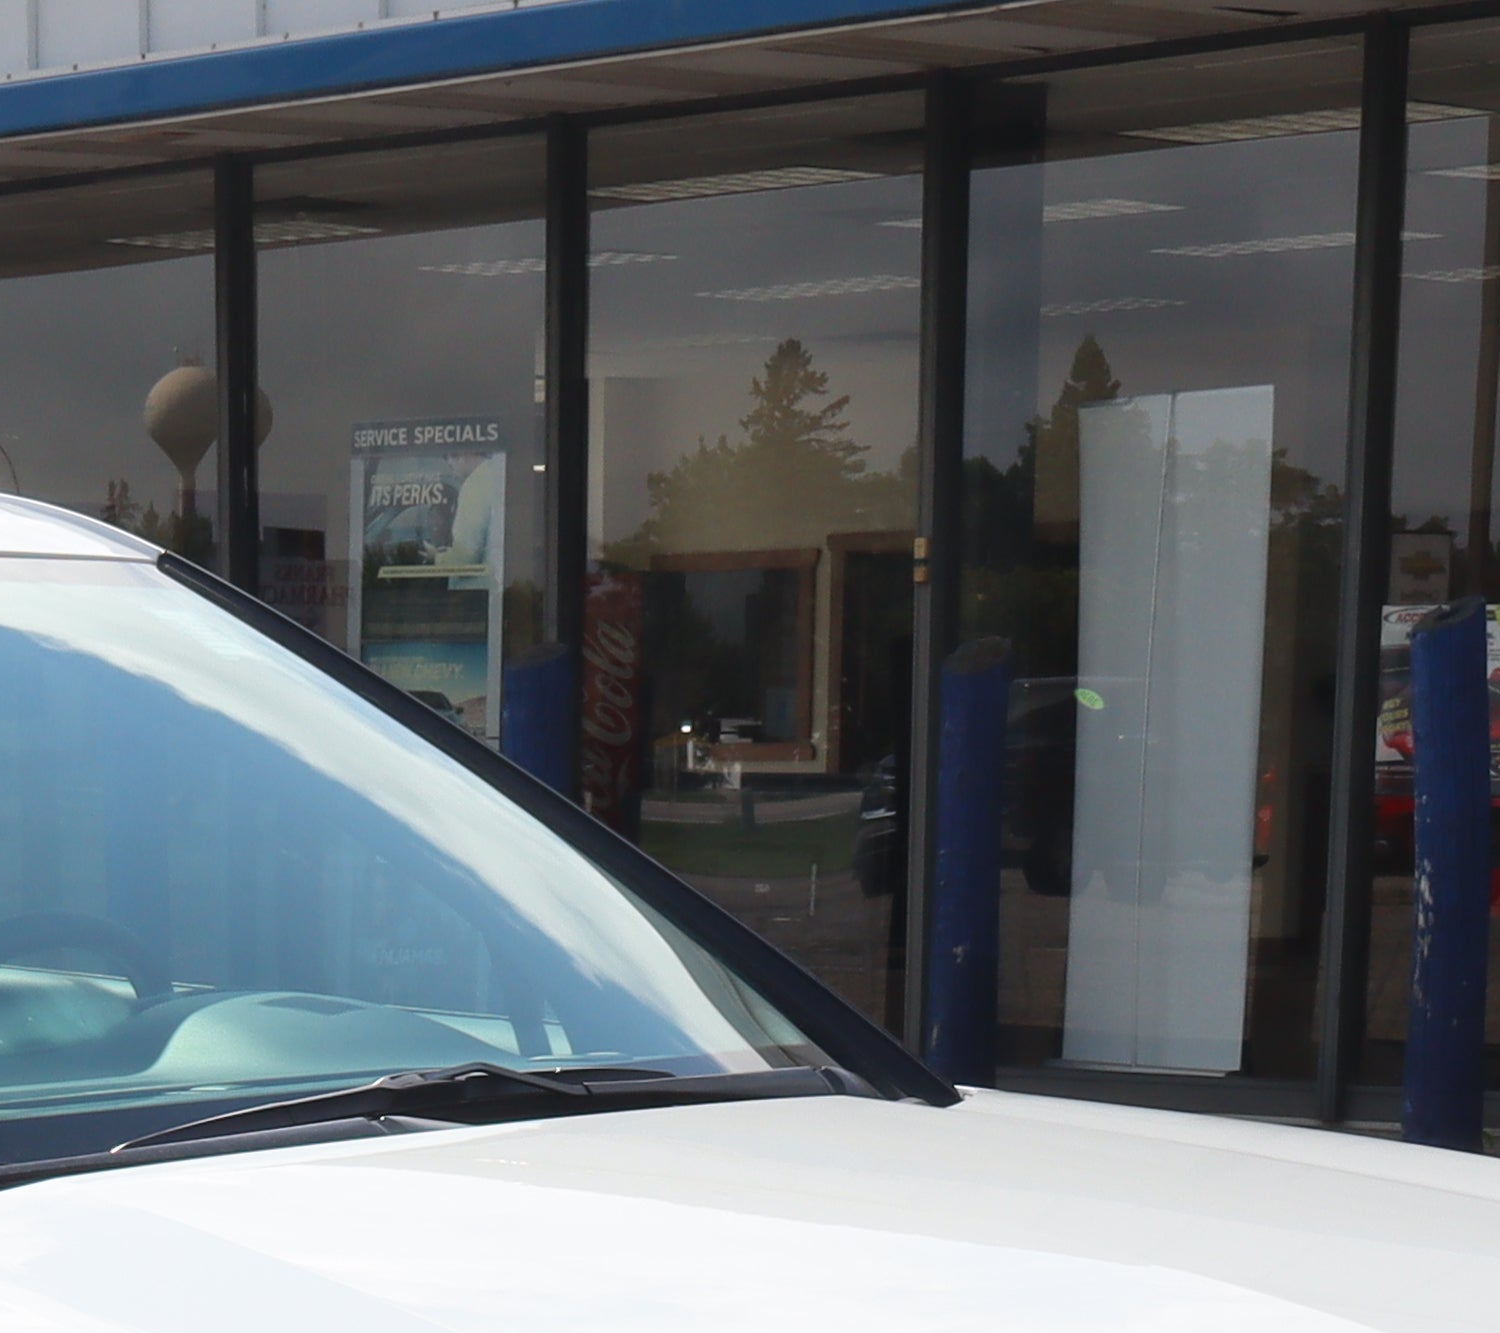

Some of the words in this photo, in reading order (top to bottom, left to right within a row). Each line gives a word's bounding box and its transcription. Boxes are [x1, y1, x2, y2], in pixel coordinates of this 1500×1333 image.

[354, 427, 408, 449] SERVICE
[413, 422, 500, 446] SPECIALS
[369, 485, 391, 507] ITS
[392, 482, 448, 506] PERKS.
